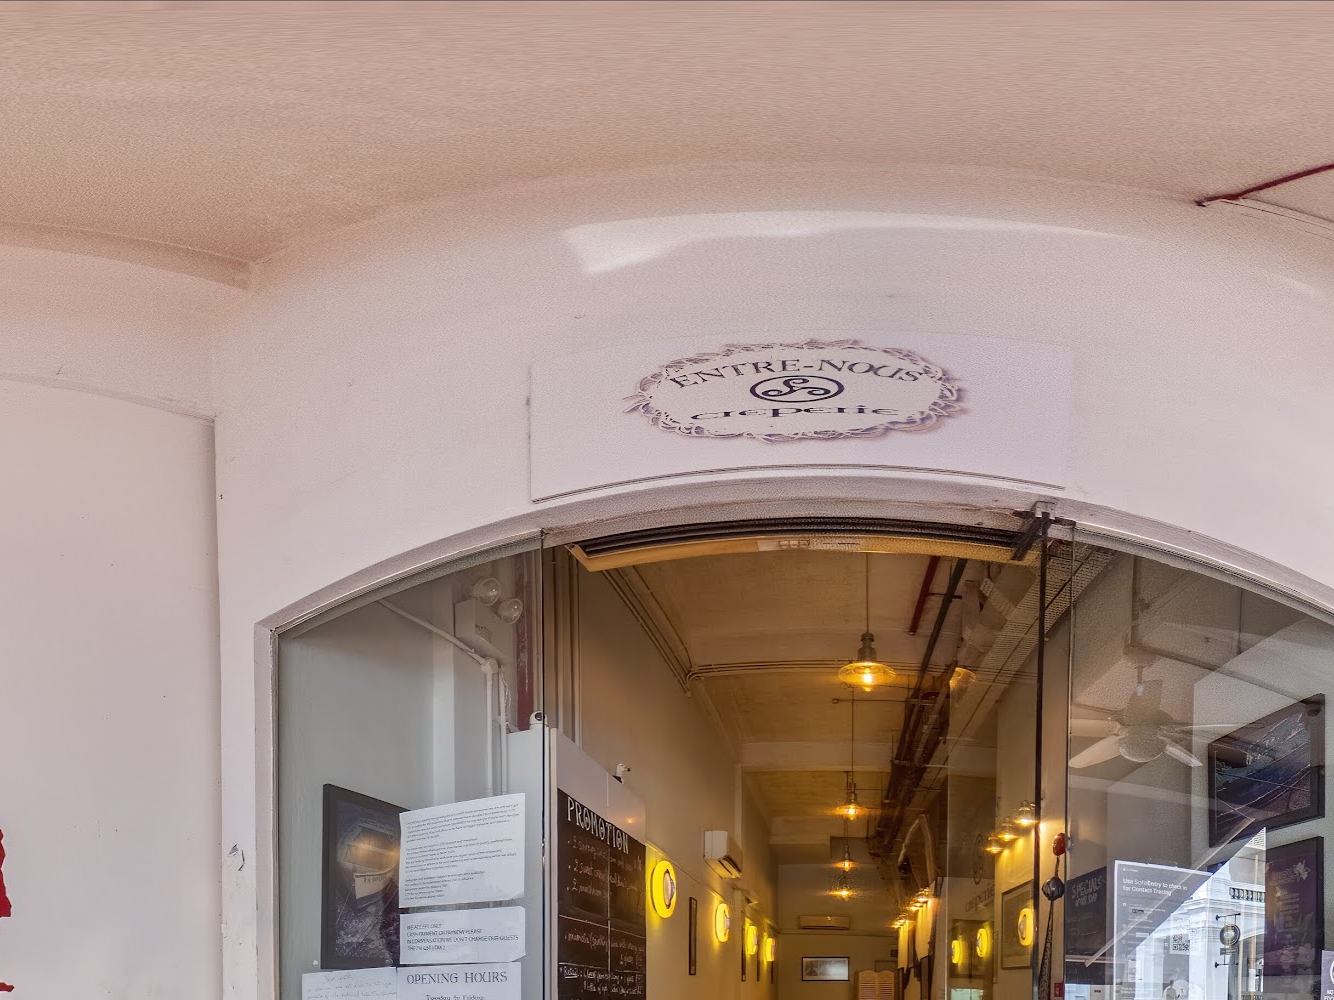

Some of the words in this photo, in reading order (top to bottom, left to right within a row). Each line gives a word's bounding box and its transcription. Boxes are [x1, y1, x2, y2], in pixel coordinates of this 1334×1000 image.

[669, 357, 923, 389] ENTRE-NOUS
[568, 796, 628, 854] PROMOTION
[1122, 877, 1134, 885] Use
[1134, 878, 1162, 888] SafeEntry
[1153, 887, 1172, 896] Tracing
[407, 972, 458, 985] OPENING
[465, 971, 508, 984] HOURS
